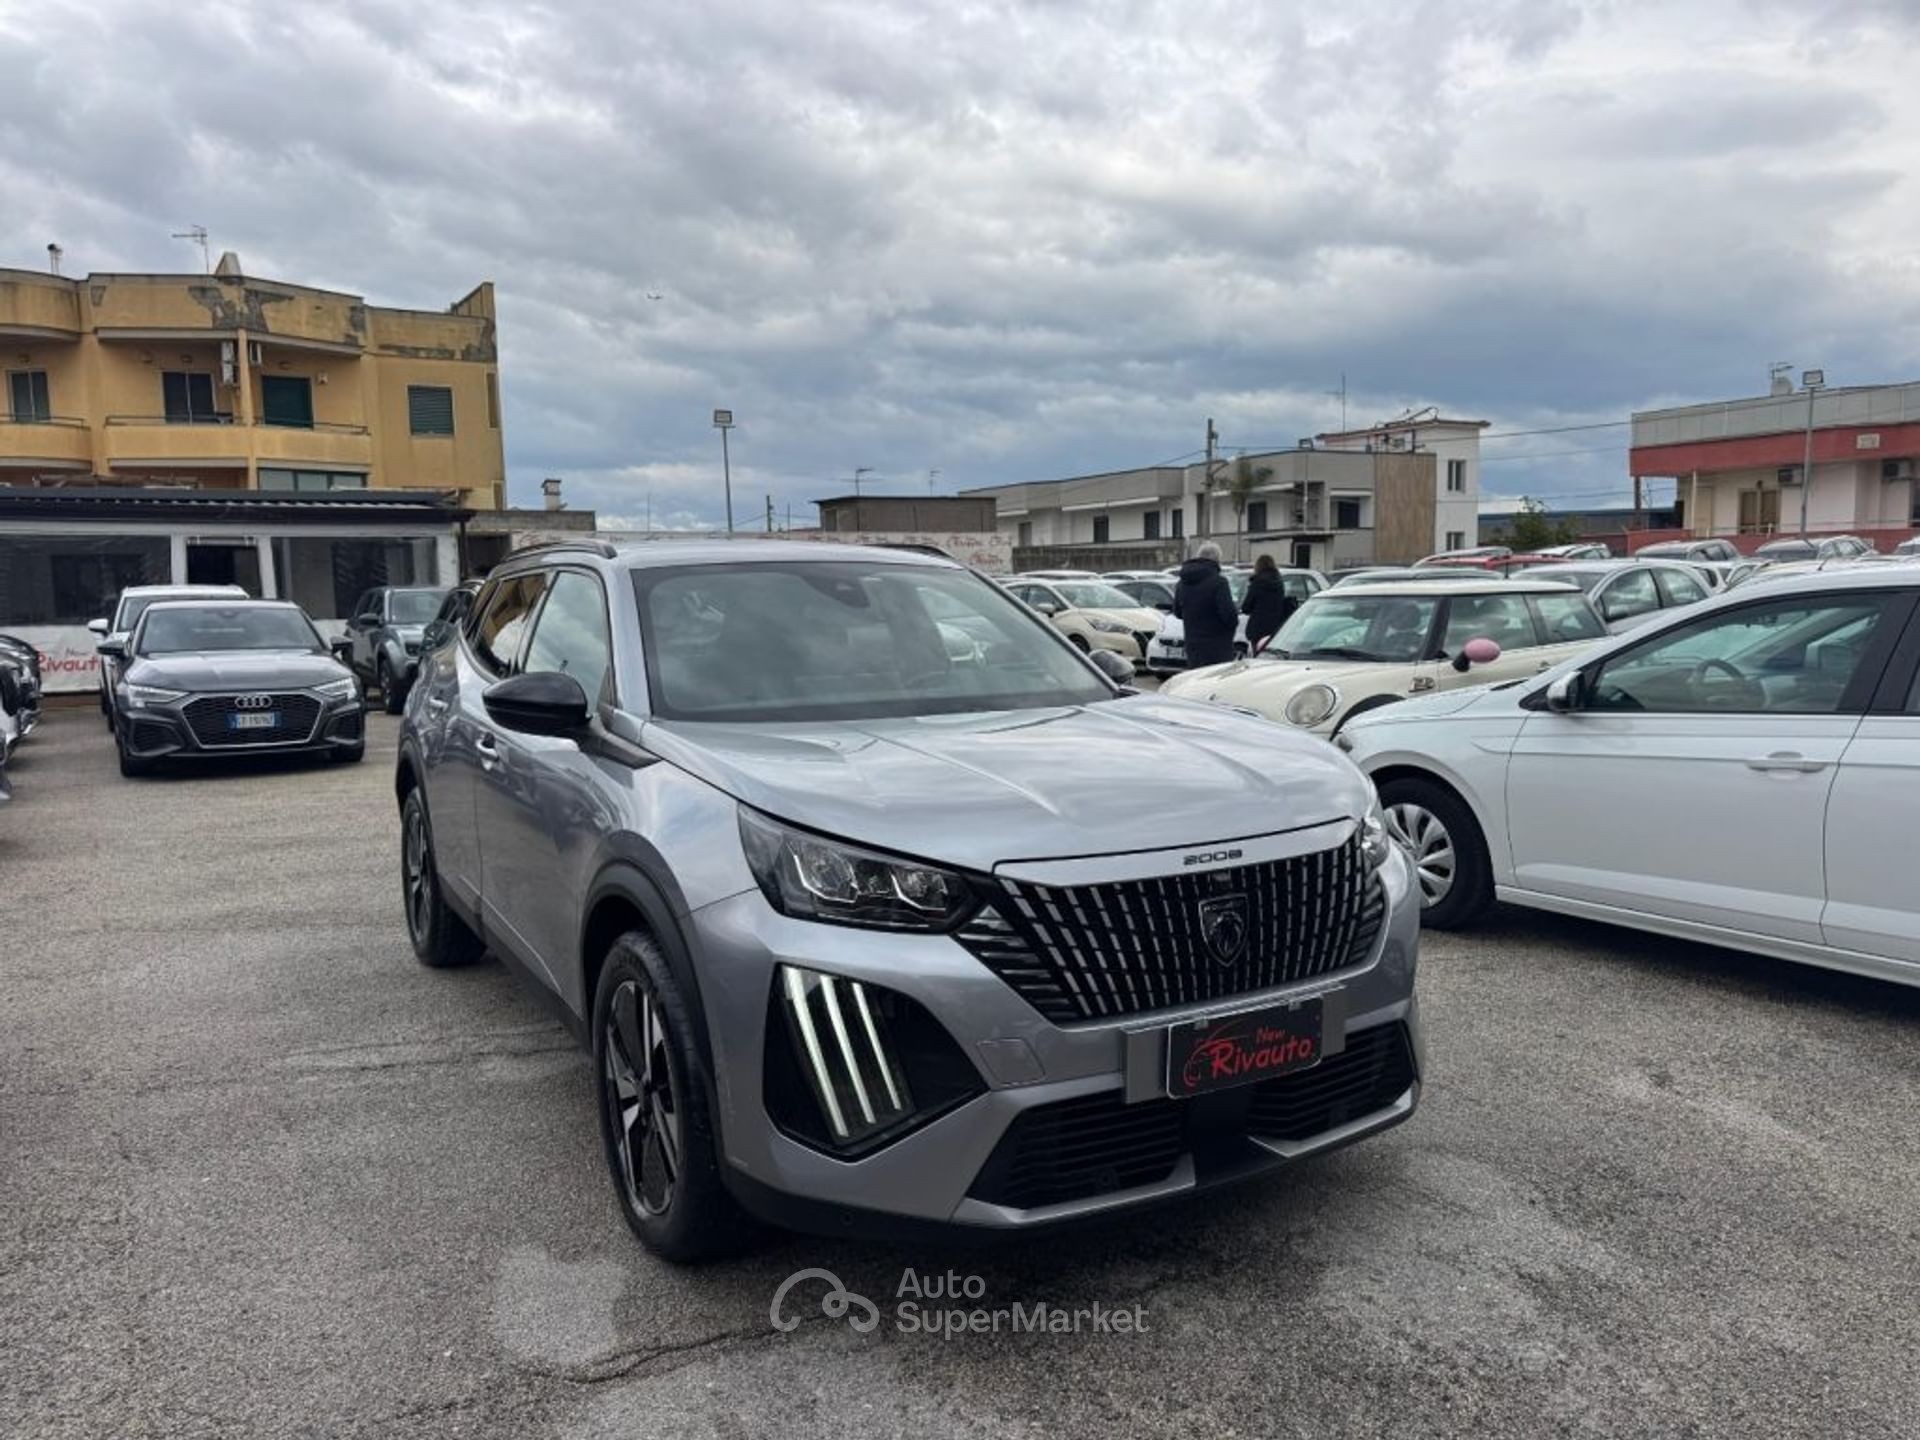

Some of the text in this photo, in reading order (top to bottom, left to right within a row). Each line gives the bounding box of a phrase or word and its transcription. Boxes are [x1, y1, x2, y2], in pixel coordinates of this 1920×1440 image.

[37, 652, 100, 672] Rivaut
[1183, 849, 1242, 866] 2008
[1256, 1027, 1286, 1043] New
[1210, 1036, 1312, 1079] Rivauto
